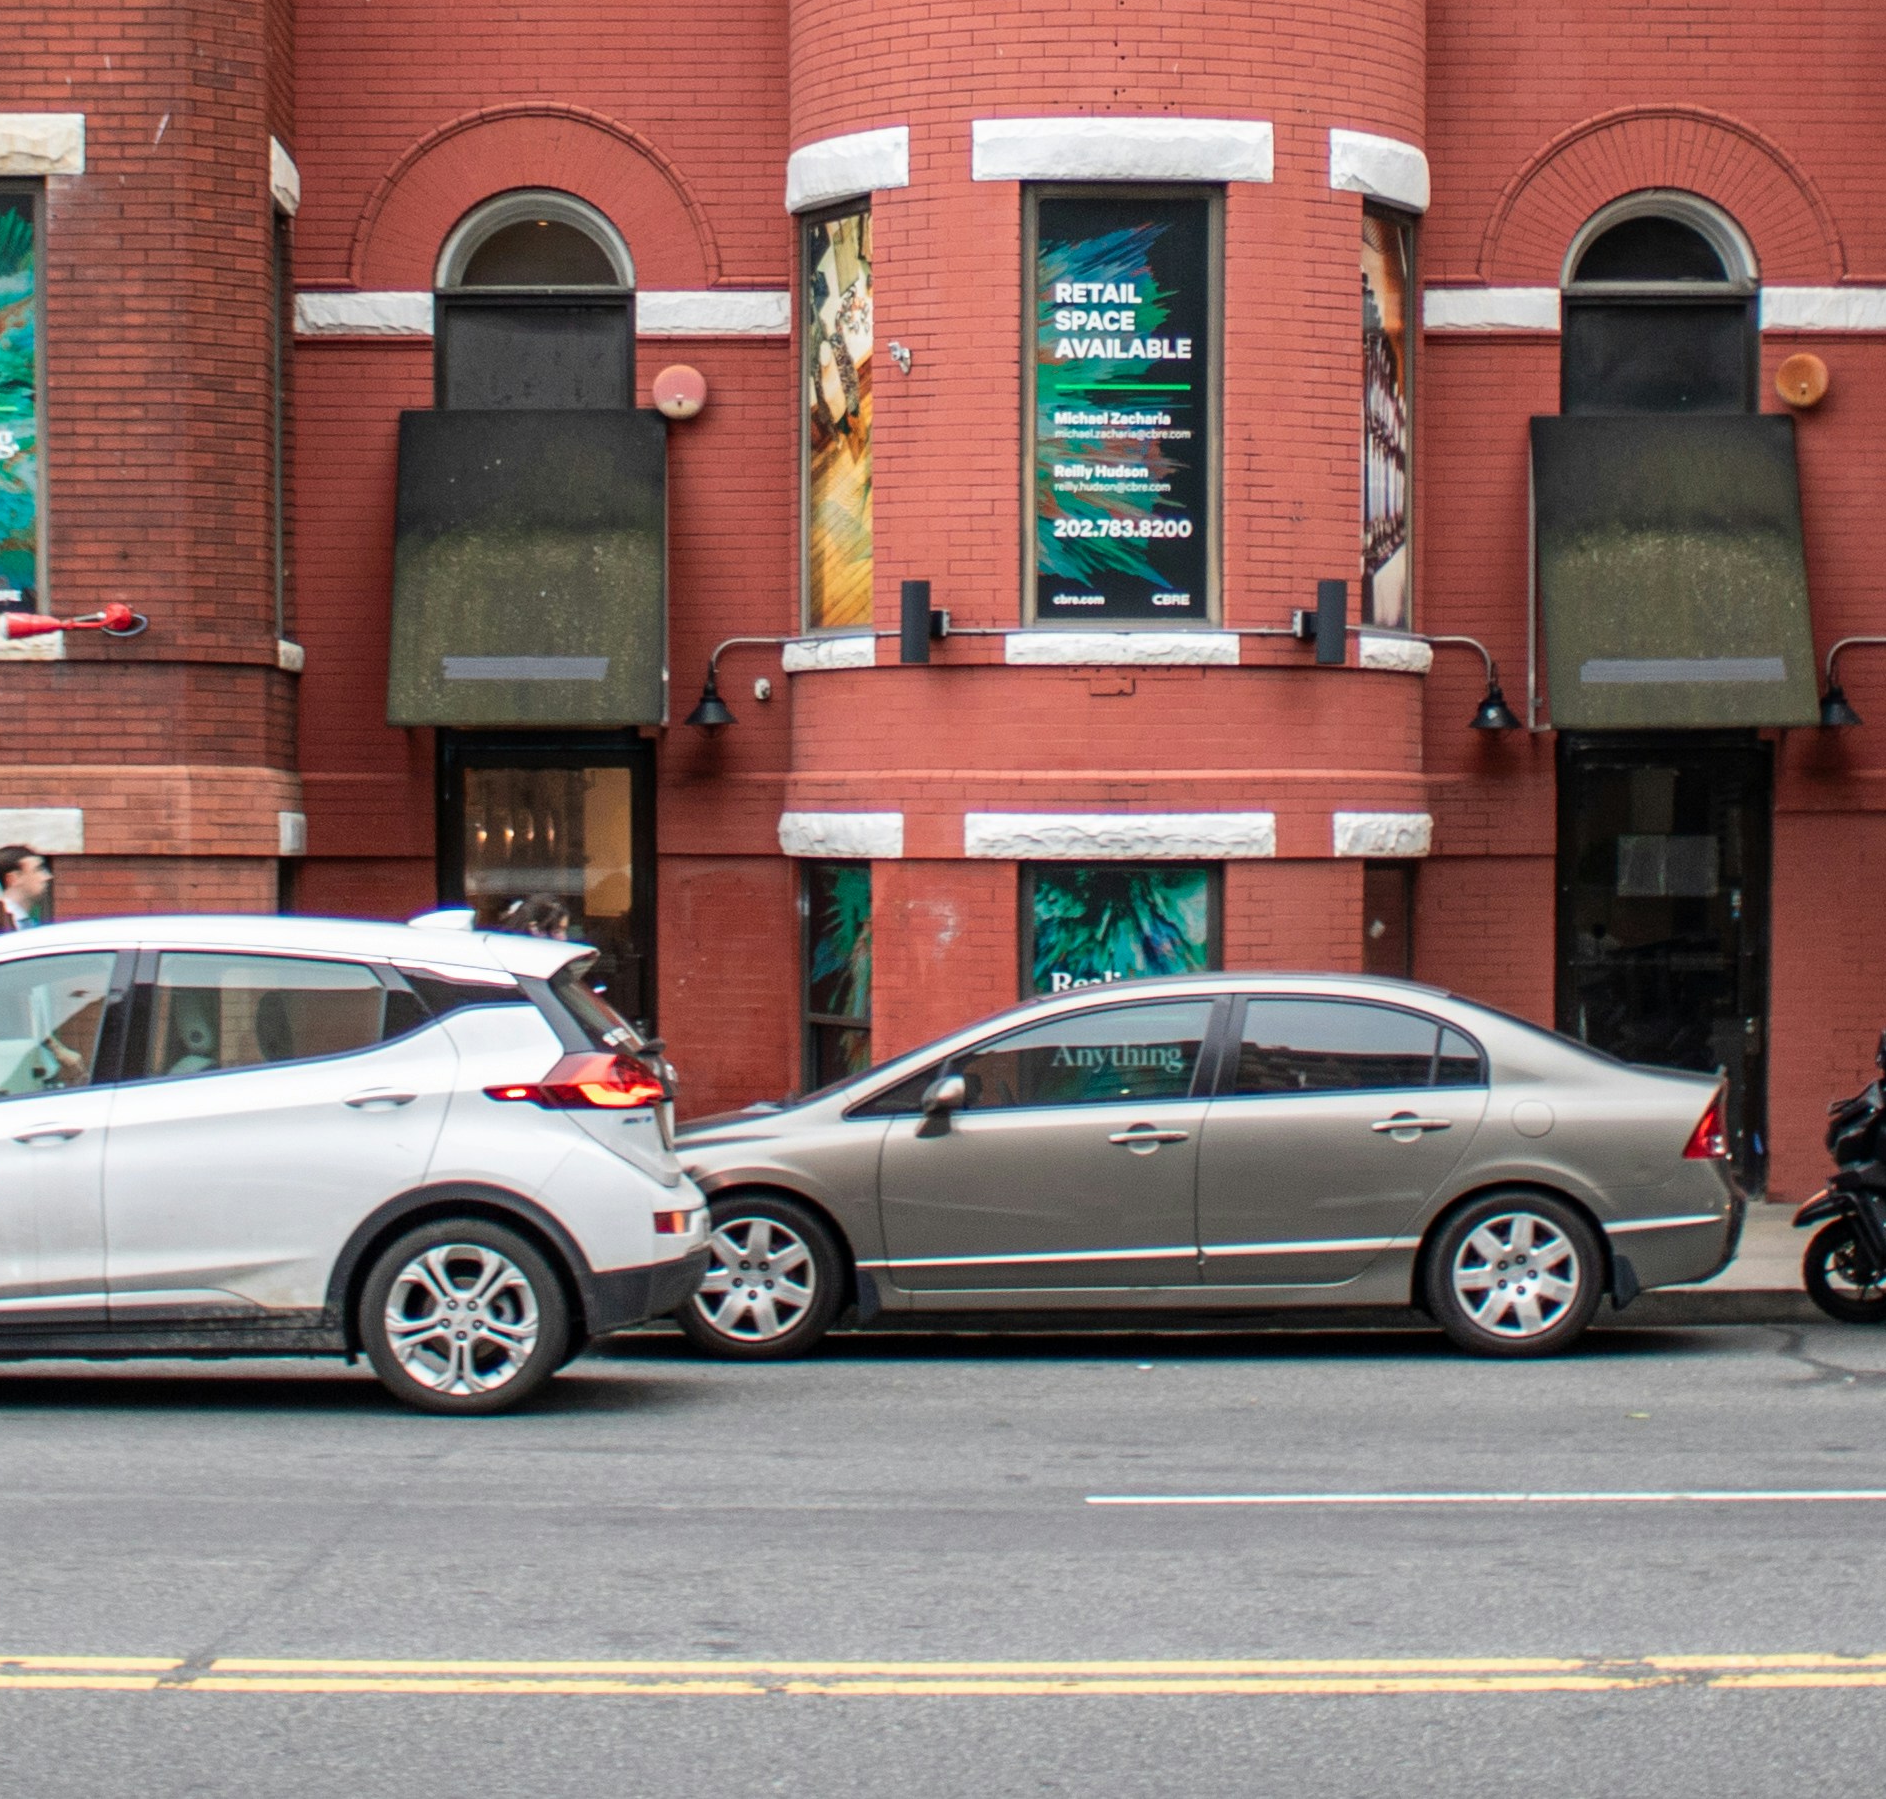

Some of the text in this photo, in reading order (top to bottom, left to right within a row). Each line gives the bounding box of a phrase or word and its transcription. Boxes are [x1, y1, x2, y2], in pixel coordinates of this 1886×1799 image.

[1055, 283, 1143, 304] RETAIL
[1055, 310, 1135, 331] SPACE
[1054, 338, 1192, 359] AVAILABLE
[1054, 412, 1171, 425] Michael Zacharia
[1053, 464, 1149, 480] Reilly Hudson
[1053, 519, 1193, 537] 202.783.8200
[1052, 594, 1105, 605] cbre.com
[1151, 593, 1190, 605] CBRE
